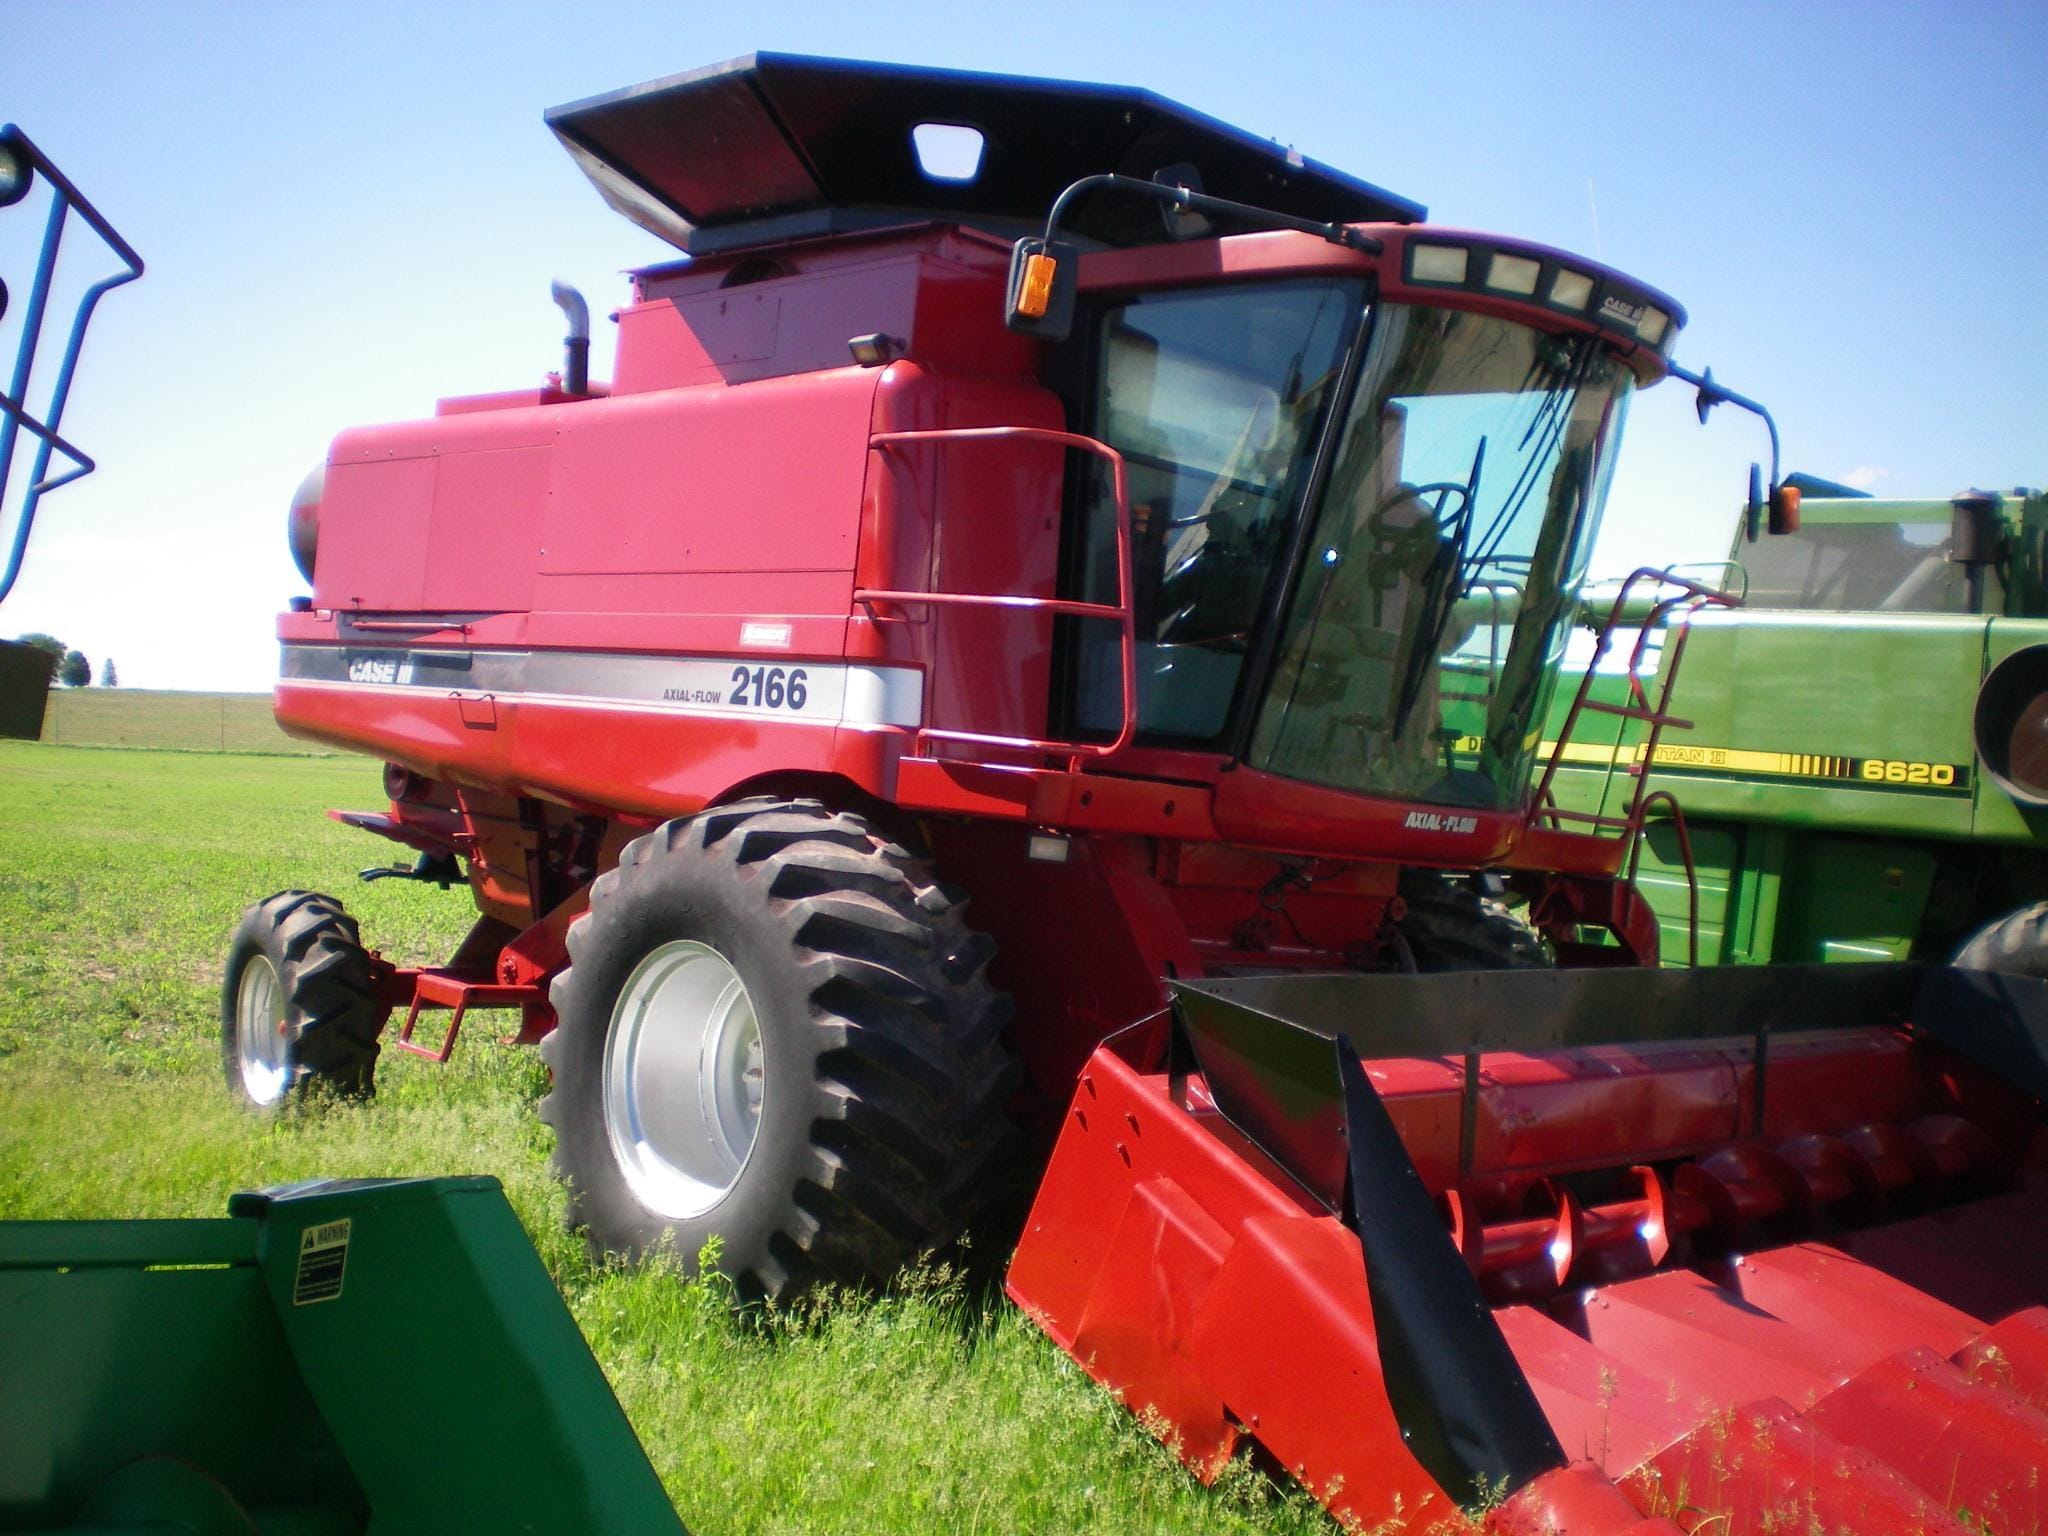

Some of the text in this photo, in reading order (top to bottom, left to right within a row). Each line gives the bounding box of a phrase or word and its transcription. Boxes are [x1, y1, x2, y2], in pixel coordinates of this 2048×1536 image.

[1603, 296, 1635, 317] CASE
[349, 658, 396, 682] CASE
[729, 666, 808, 710] 2166
[1863, 759, 1955, 785] 6620
